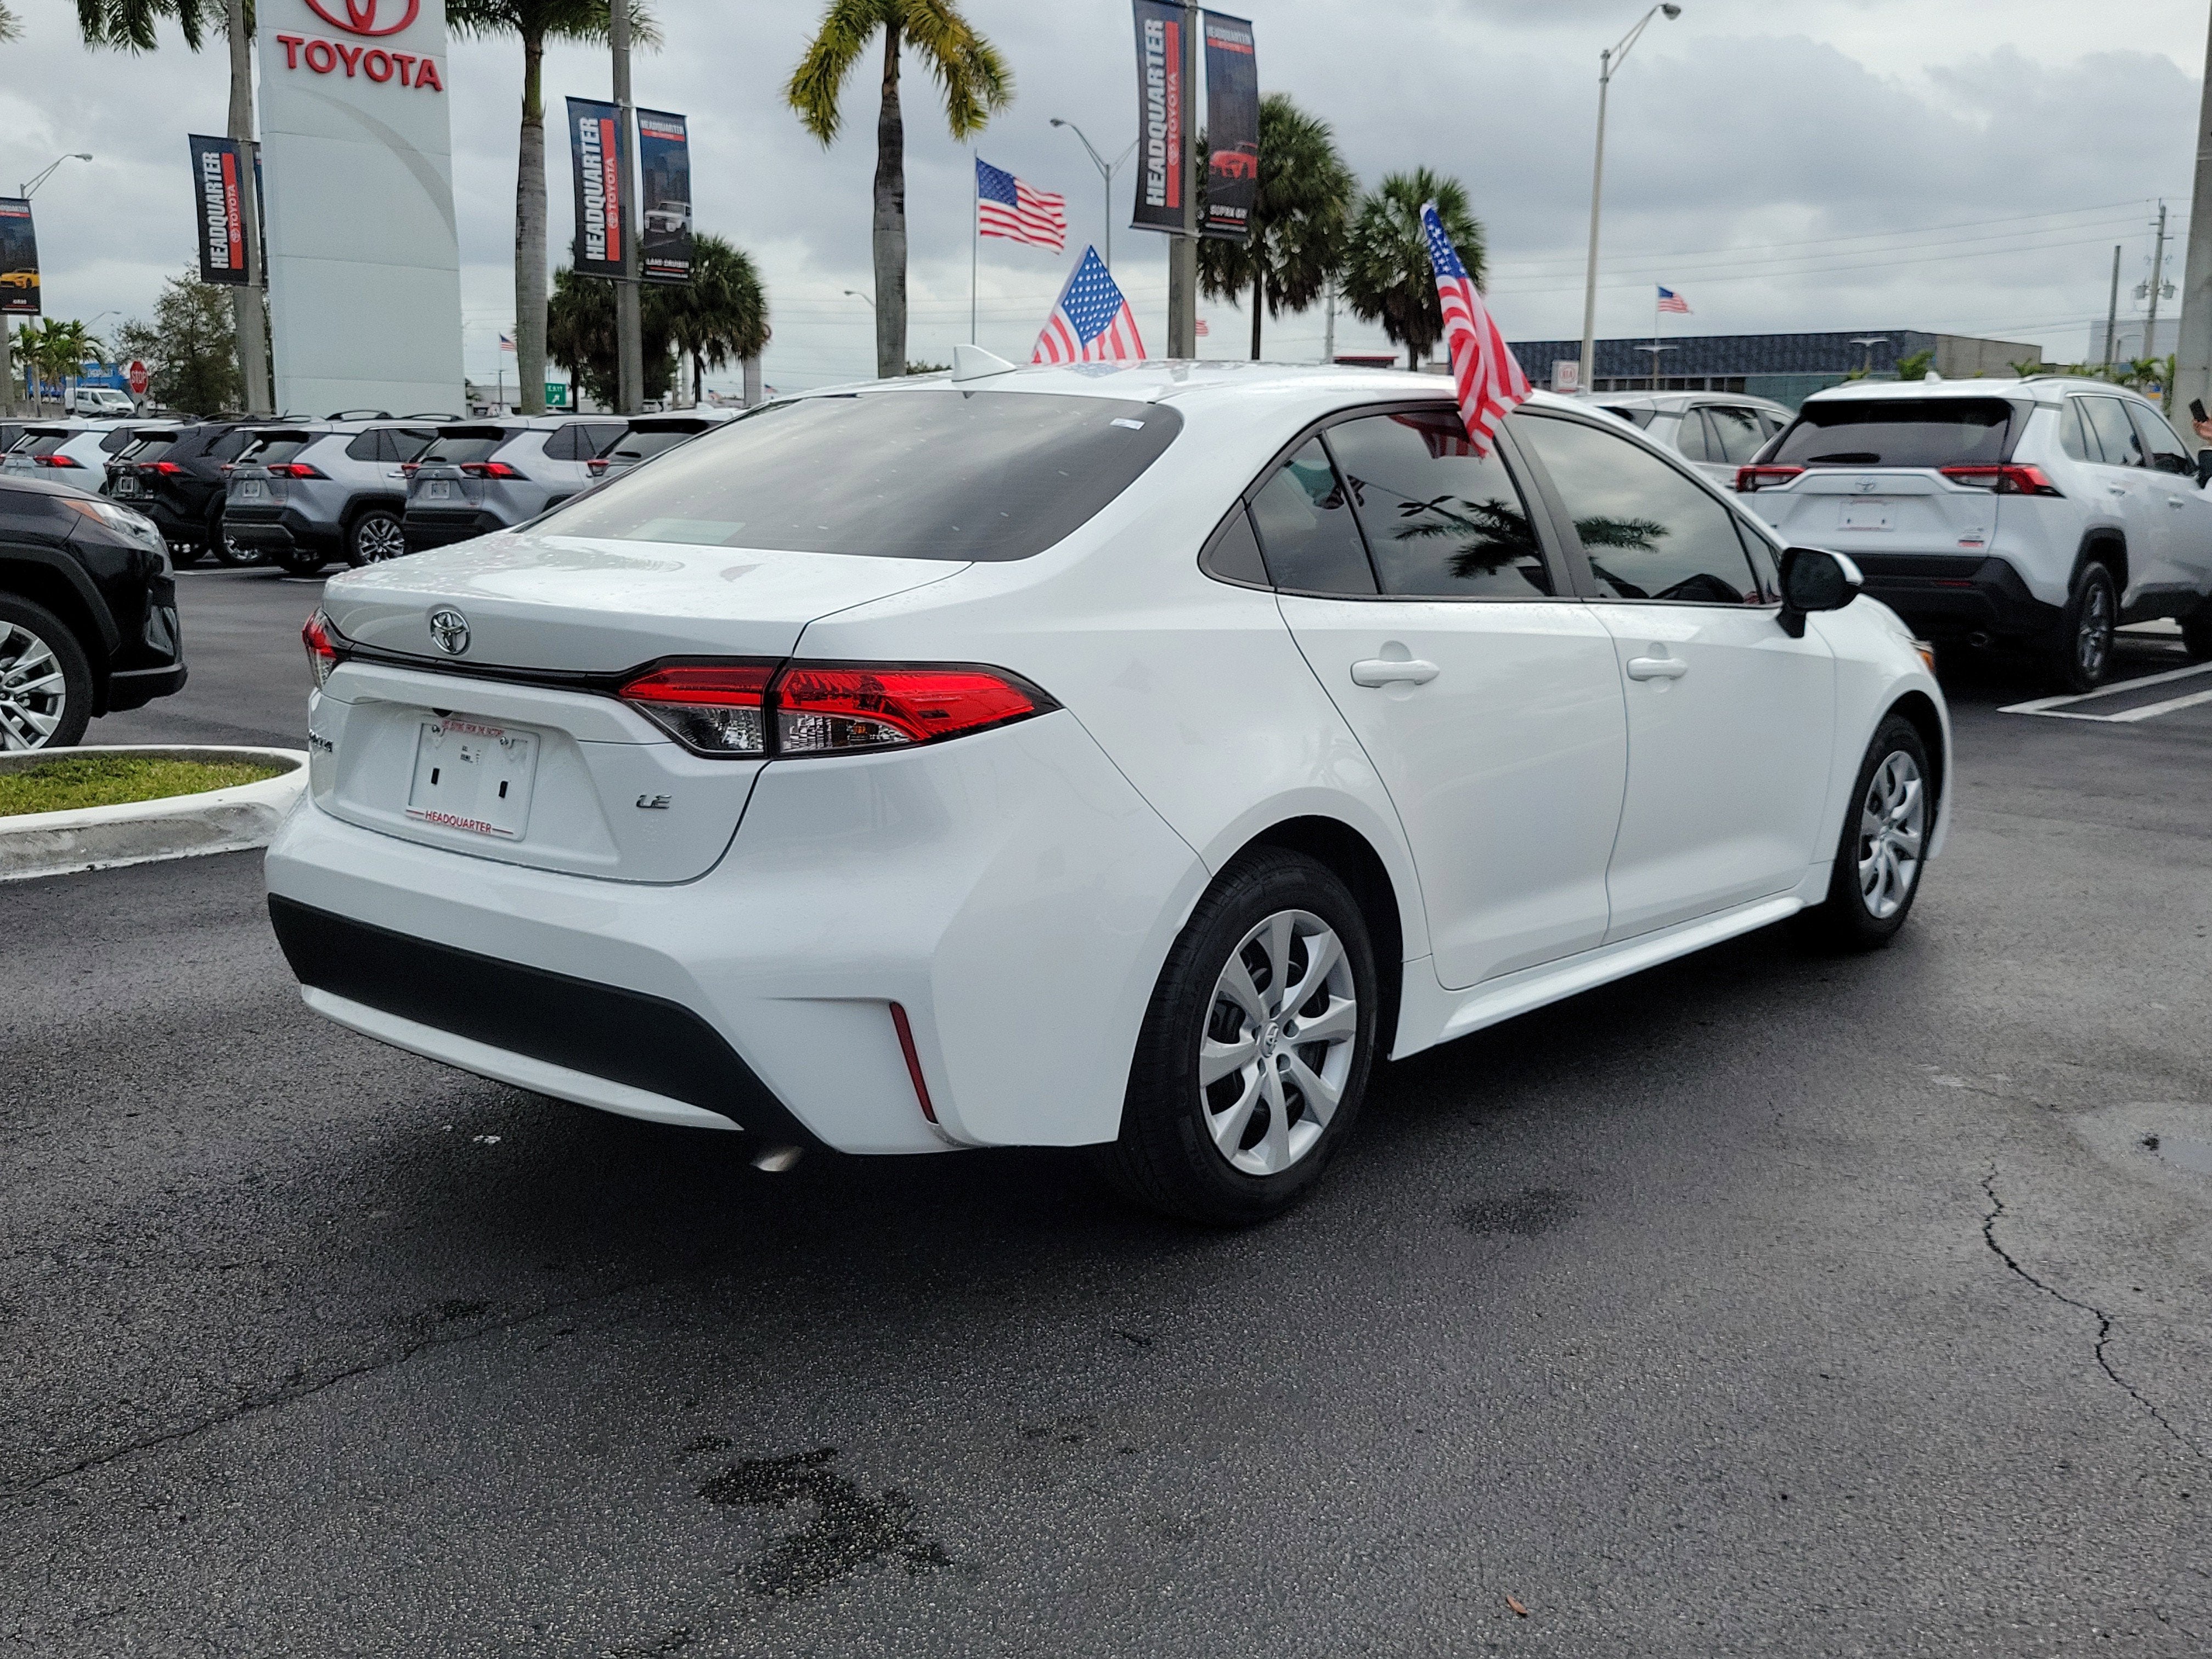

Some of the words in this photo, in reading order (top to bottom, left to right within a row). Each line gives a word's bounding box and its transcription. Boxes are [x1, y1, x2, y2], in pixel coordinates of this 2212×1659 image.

[277, 35, 443, 91] TOYOTA
[1145, 19, 1167, 206] HEADQUARTER
[1167, 72, 1178, 142] TOYOTA
[202, 152, 229, 268] HEADQUARTER
[228, 184, 239, 227] TOYOTA
[579, 117, 606, 261] HEADQUARTER
[606, 157, 617, 210] TOYOTA
[131, 370, 147, 383] STOP
[425, 810, 492, 833] HEADQUARTER
[636, 794, 672, 809] LE
